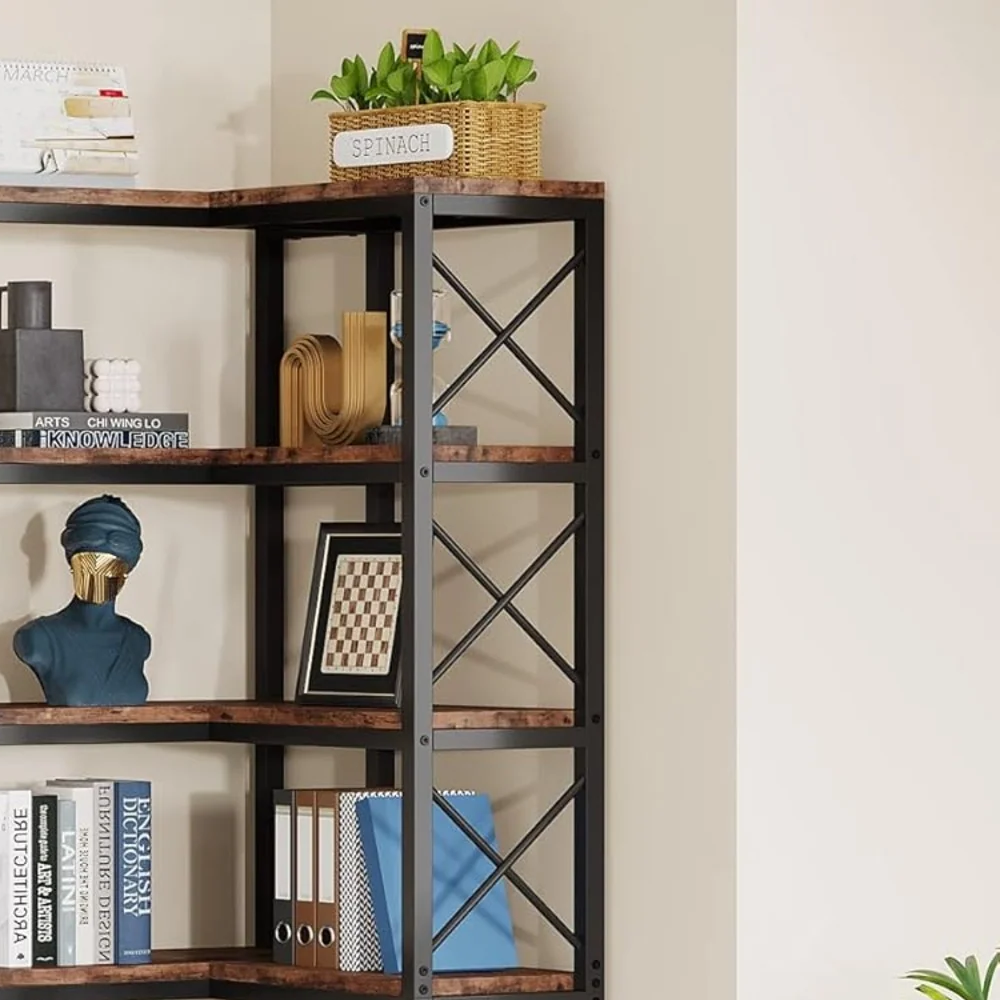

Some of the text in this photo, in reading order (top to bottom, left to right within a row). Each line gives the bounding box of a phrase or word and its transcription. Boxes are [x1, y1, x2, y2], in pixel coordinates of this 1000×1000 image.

[3, 68, 68, 83] MARCH
[352, 133, 430, 158] SPINACH
[35, 417, 161, 429] ARTS CHI WING LO
[123, 798, 138, 917] DICTIONARY
[138, 798, 151, 916] ENGLISH
[37, 862, 52, 885] ART
[37, 897, 52, 943] ARTISTS
